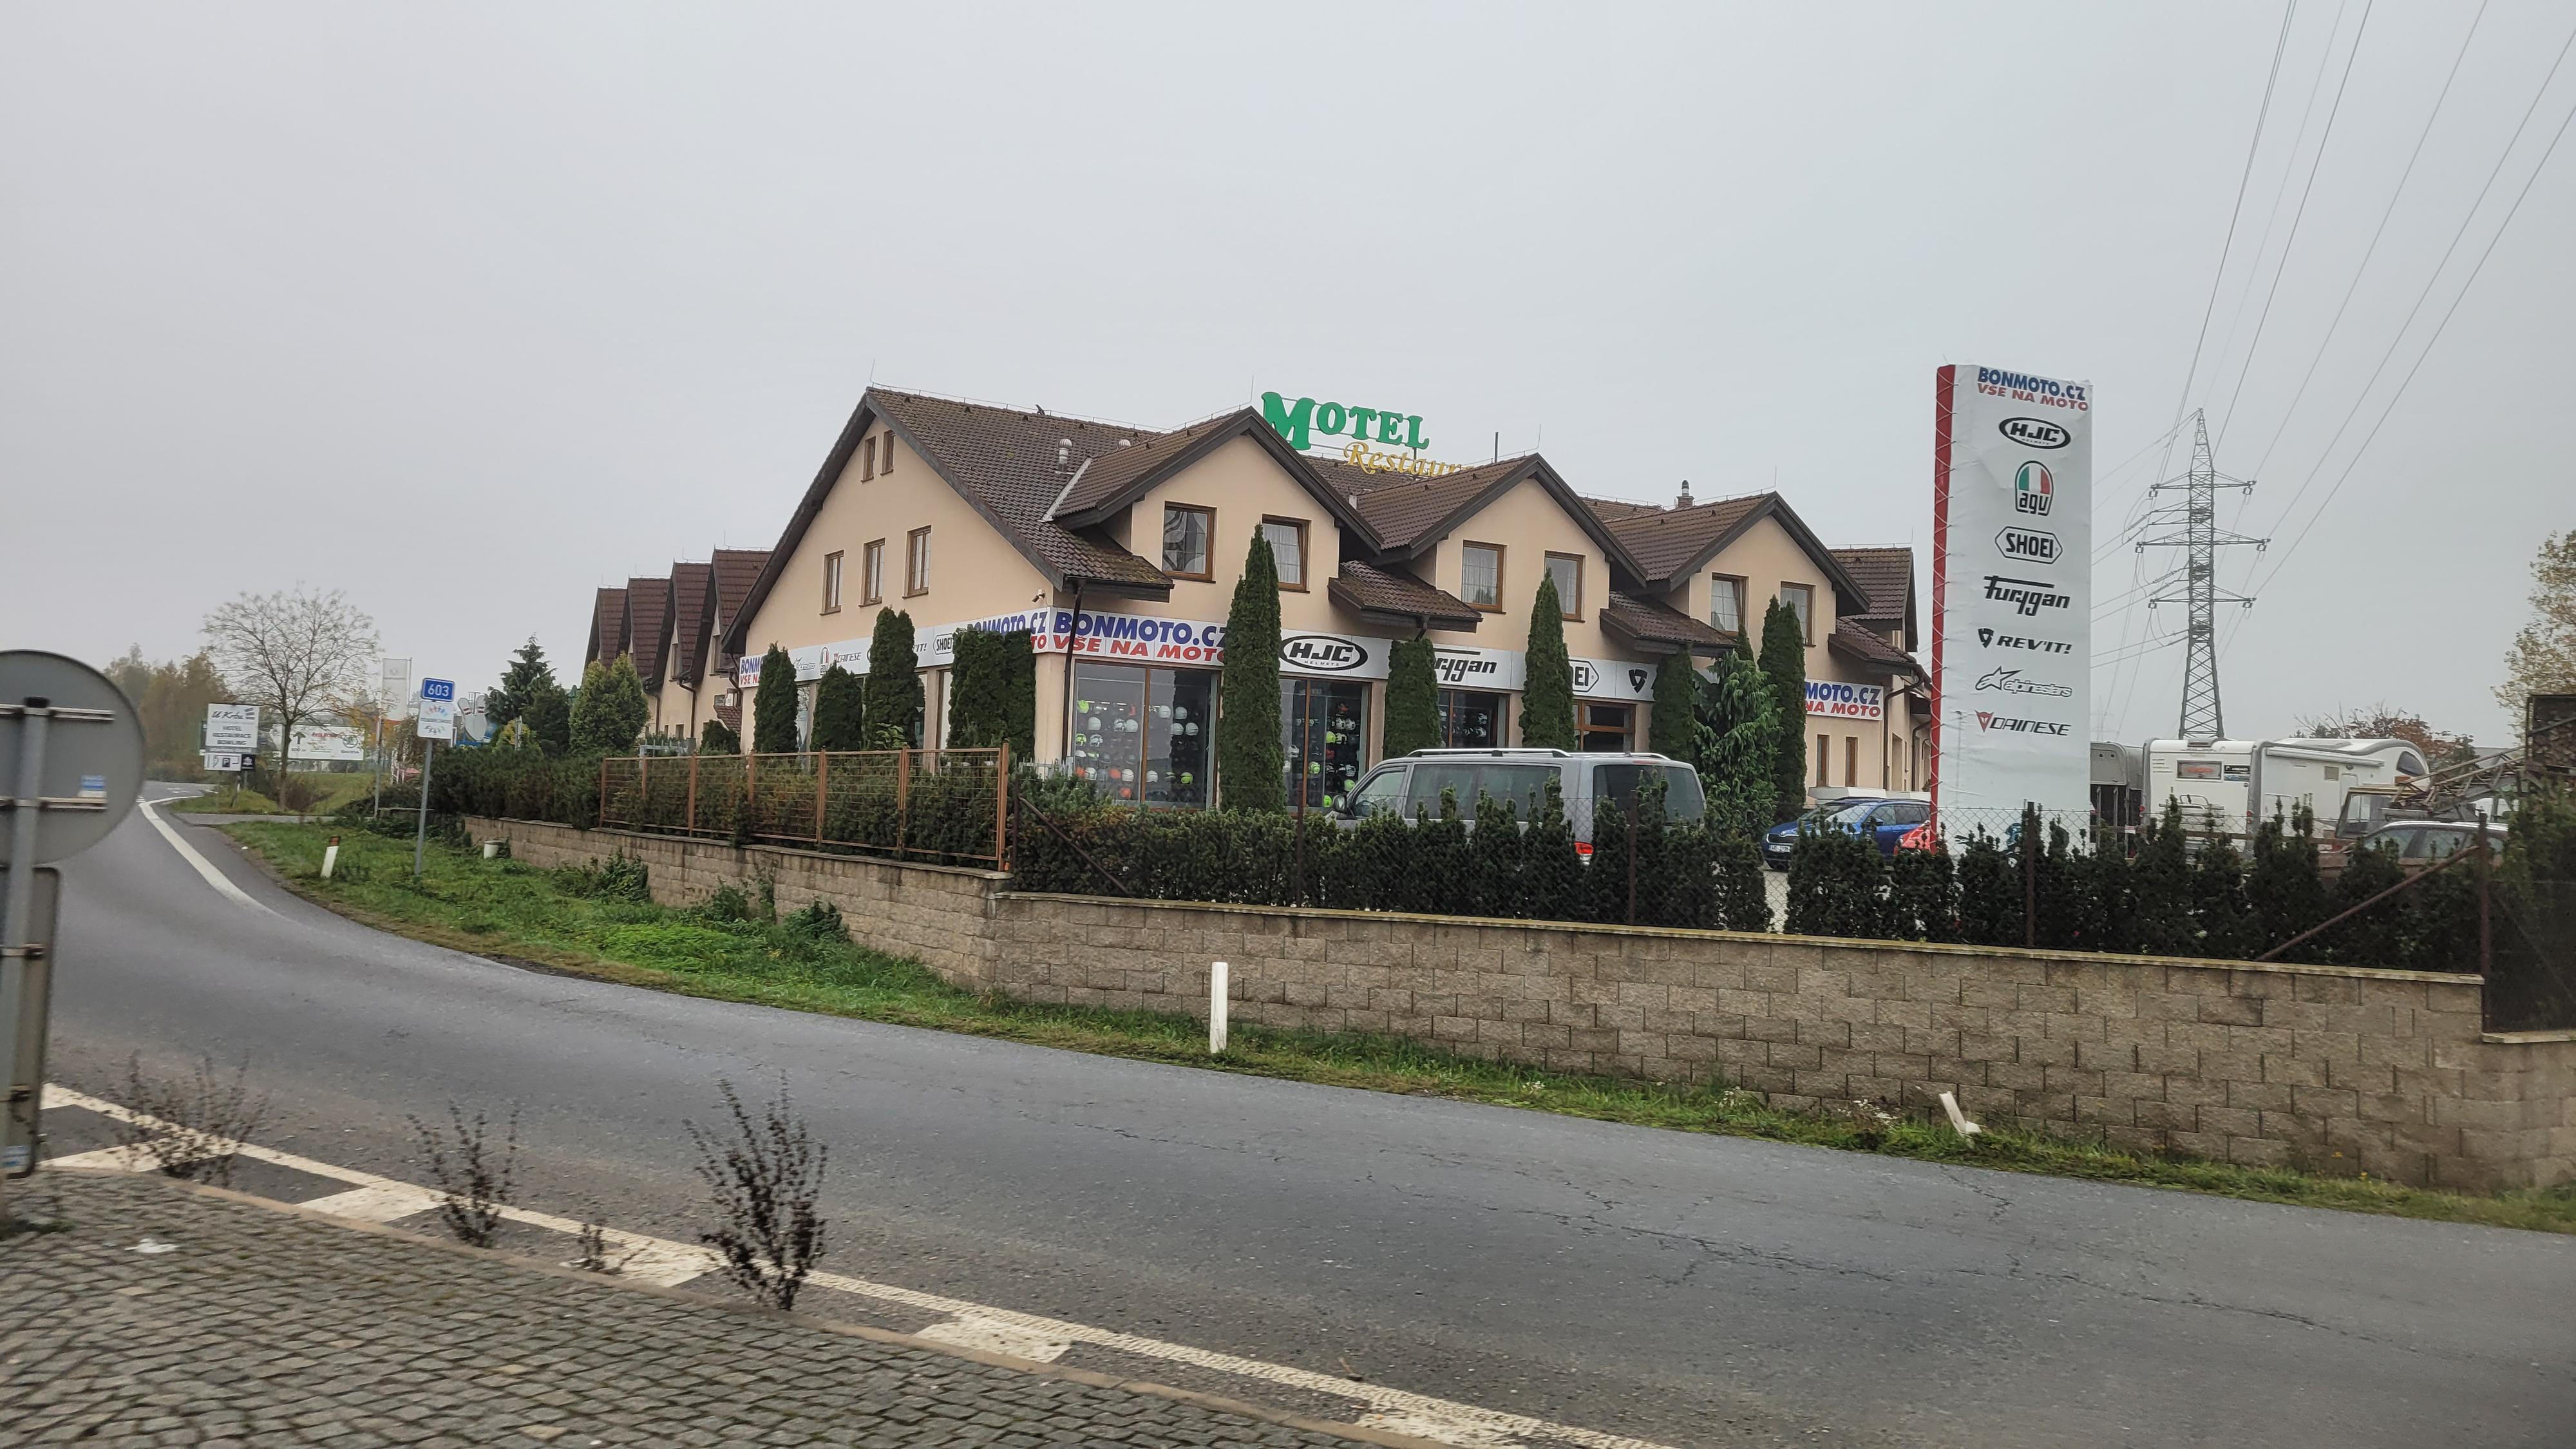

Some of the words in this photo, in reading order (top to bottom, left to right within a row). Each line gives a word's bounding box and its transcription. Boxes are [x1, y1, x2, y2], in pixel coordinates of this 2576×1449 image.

[1978, 366, 2086, 401] BONMOTO.CZ
[2011, 389, 2036, 403] NA
[2040, 396, 2089, 412] MOTO
[1261, 391, 1430, 450] MOTEL
[2009, 422, 2060, 443] HJC
[1343, 441, 1475, 477] Restaur
[2019, 492, 2050, 515] agv
[2005, 533, 2054, 559] SHOEI
[1053, 611, 1227, 647] BONMOTO.CZ
[1030, 634, 1047, 650] TO
[1052, 634, 1102, 652] VŠE
[1110, 639, 1148, 656] NA
[1289, 642, 1354, 662] HJC
[428, 684, 450, 697] 603
[1804, 681, 1881, 705] MOTO.CZ
[2003, 679, 2072, 698] alpinestars
[1830, 703, 1881, 717] MOTO
[1990, 717, 2072, 736] DAINESE
